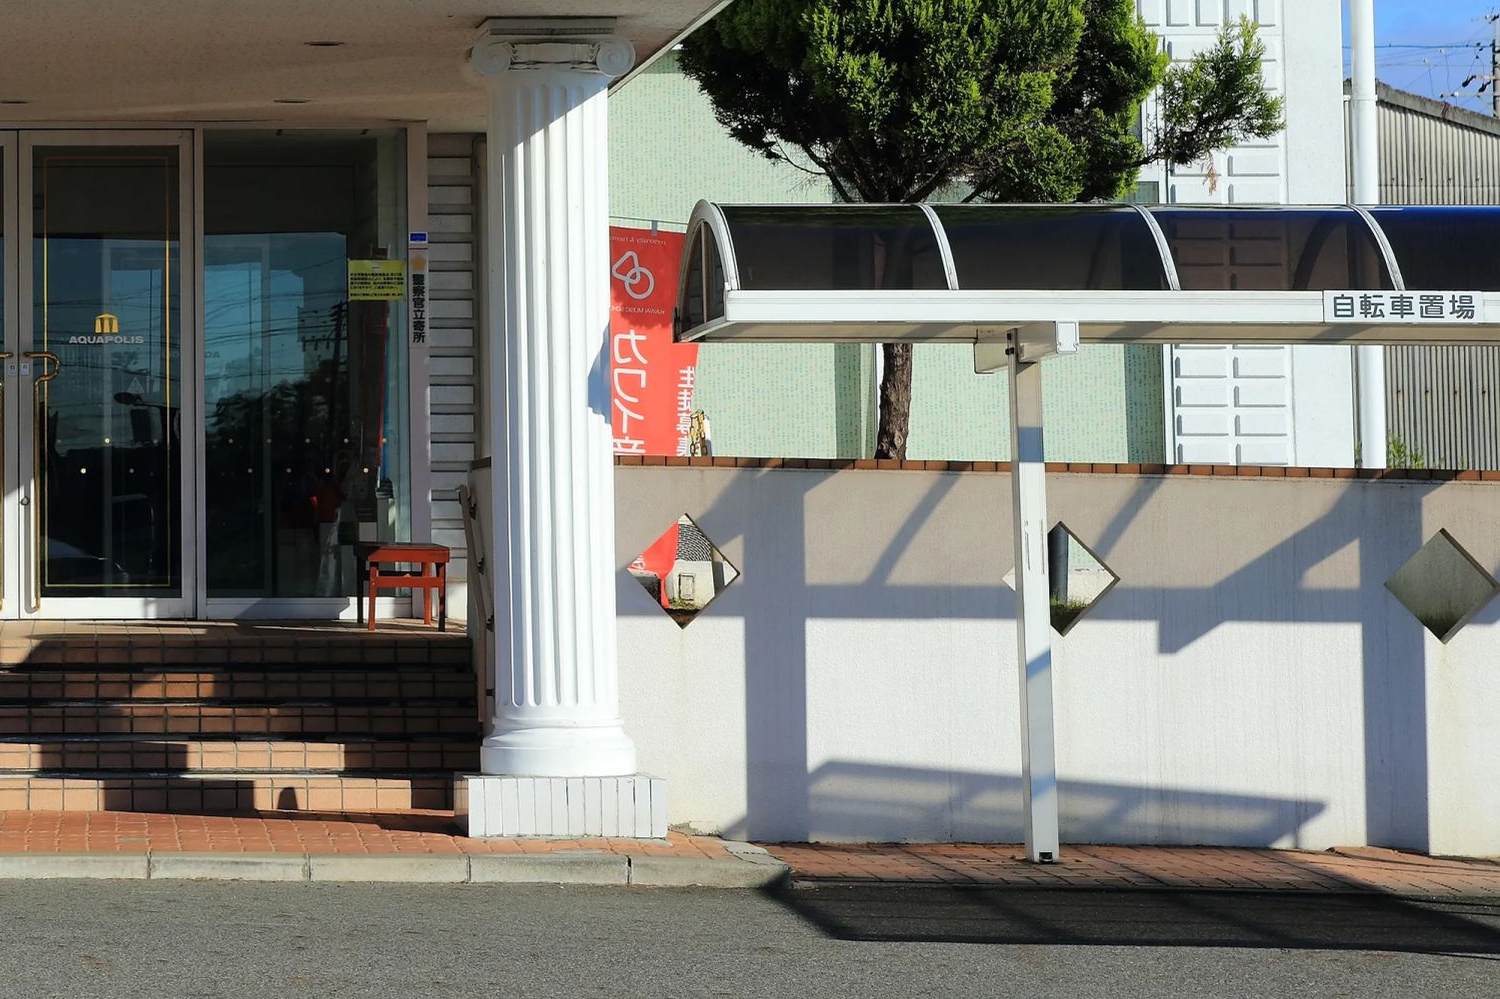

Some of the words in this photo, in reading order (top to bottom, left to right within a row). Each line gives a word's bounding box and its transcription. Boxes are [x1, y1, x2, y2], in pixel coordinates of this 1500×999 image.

[412, 273, 426, 343] 警察官立寄所
[1333, 293, 1475, 319] 自転車置場
[68, 335, 145, 345] AQUAPOLIS
